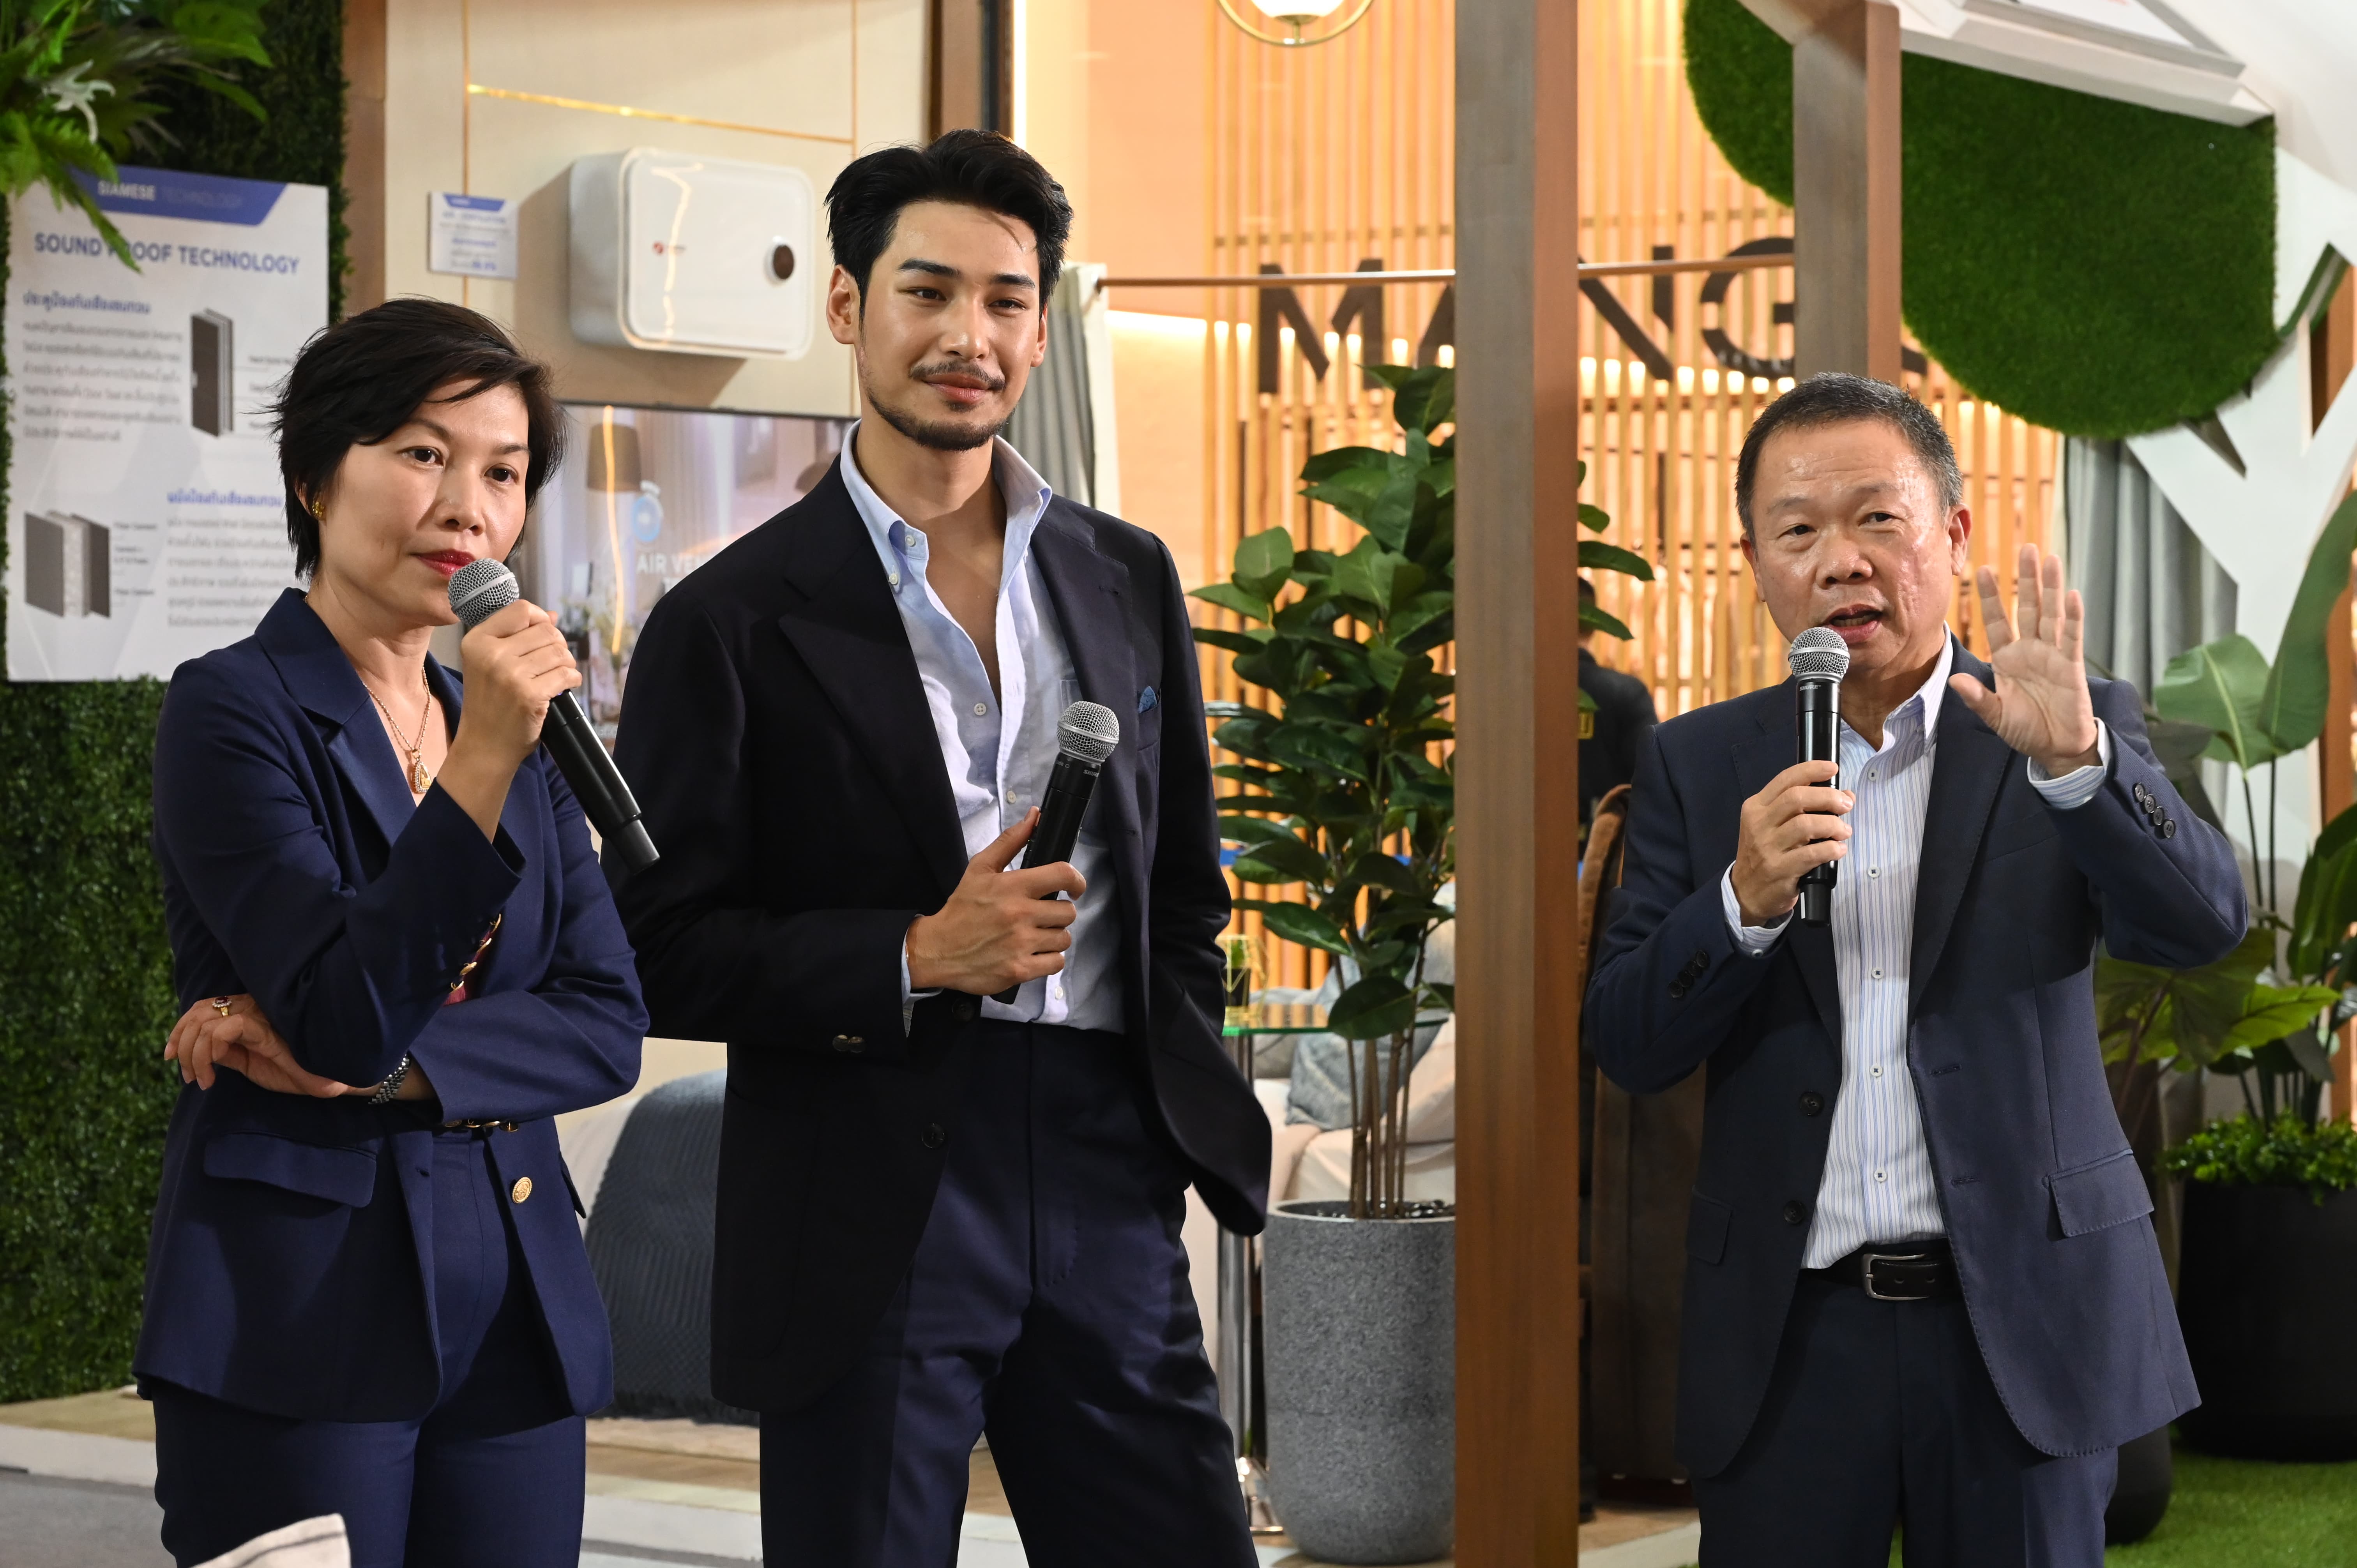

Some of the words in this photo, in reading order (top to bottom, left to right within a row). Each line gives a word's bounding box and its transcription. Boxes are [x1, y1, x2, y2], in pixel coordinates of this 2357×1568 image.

[97, 180, 155, 201] SIAMESE
[34, 232, 102, 256] SOUND
[178, 245, 300, 275] TECHNOLOGY
[636, 552, 667, 575] AIR
